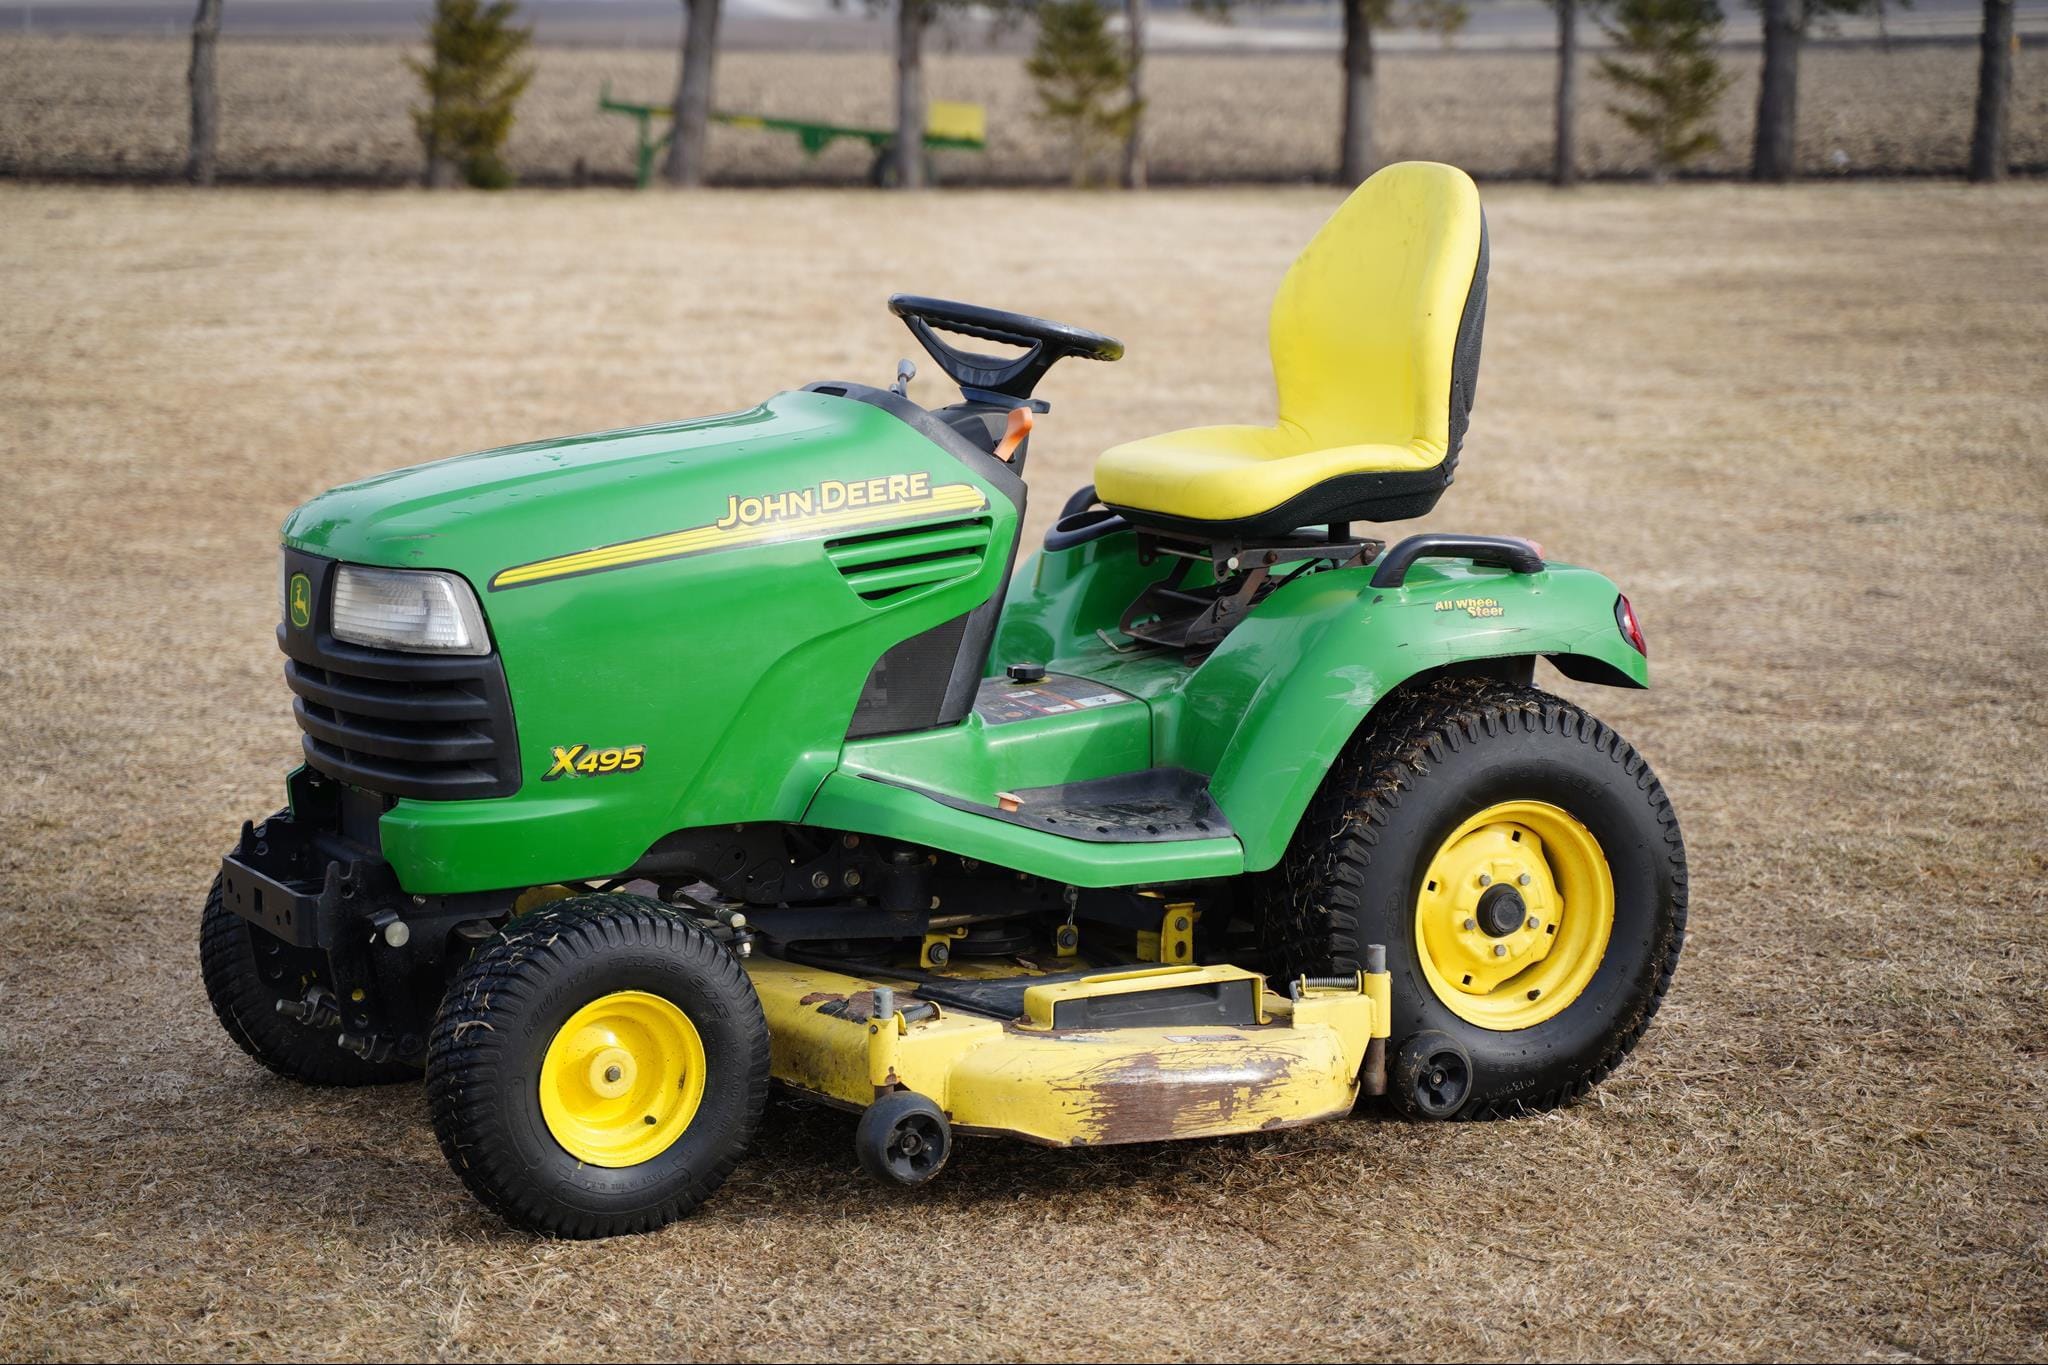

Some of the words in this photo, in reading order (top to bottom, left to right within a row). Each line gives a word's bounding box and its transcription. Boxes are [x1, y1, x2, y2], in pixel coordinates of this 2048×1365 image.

[717, 489, 813, 528] JOHN
[820, 472, 930, 511] DEERE
[1434, 600, 1453, 611] All
[1466, 606, 1503, 617] Steer
[541, 744, 645, 781] X495
